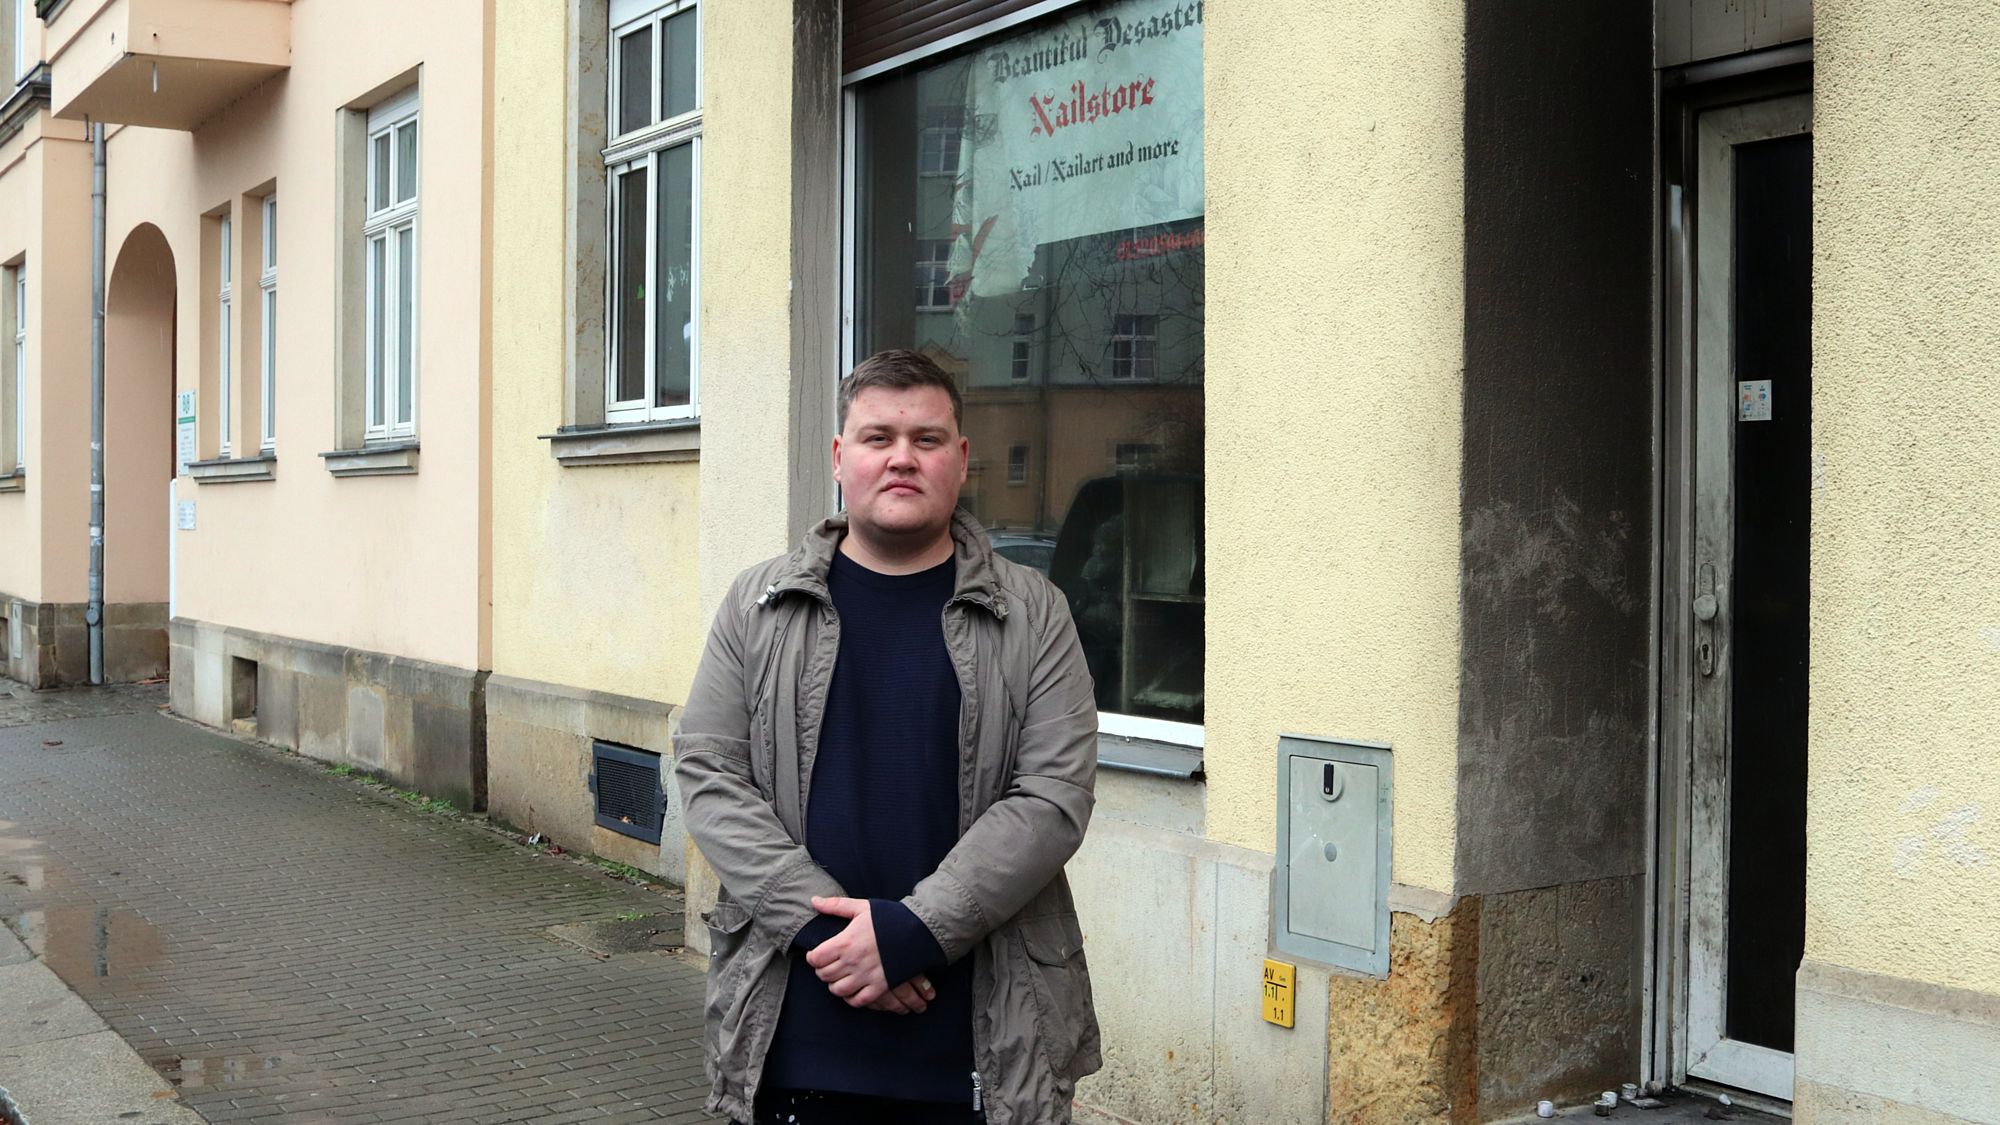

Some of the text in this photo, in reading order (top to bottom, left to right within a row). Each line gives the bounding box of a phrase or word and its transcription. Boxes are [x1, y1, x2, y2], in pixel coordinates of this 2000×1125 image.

[1029, 75, 1156, 139] Nailstore
[1107, 140, 1134, 169] and
[1138, 139, 1179, 162] more
[1264, 967, 1274, 980] AV
[1273, 1007, 1284, 1021] 1.1
